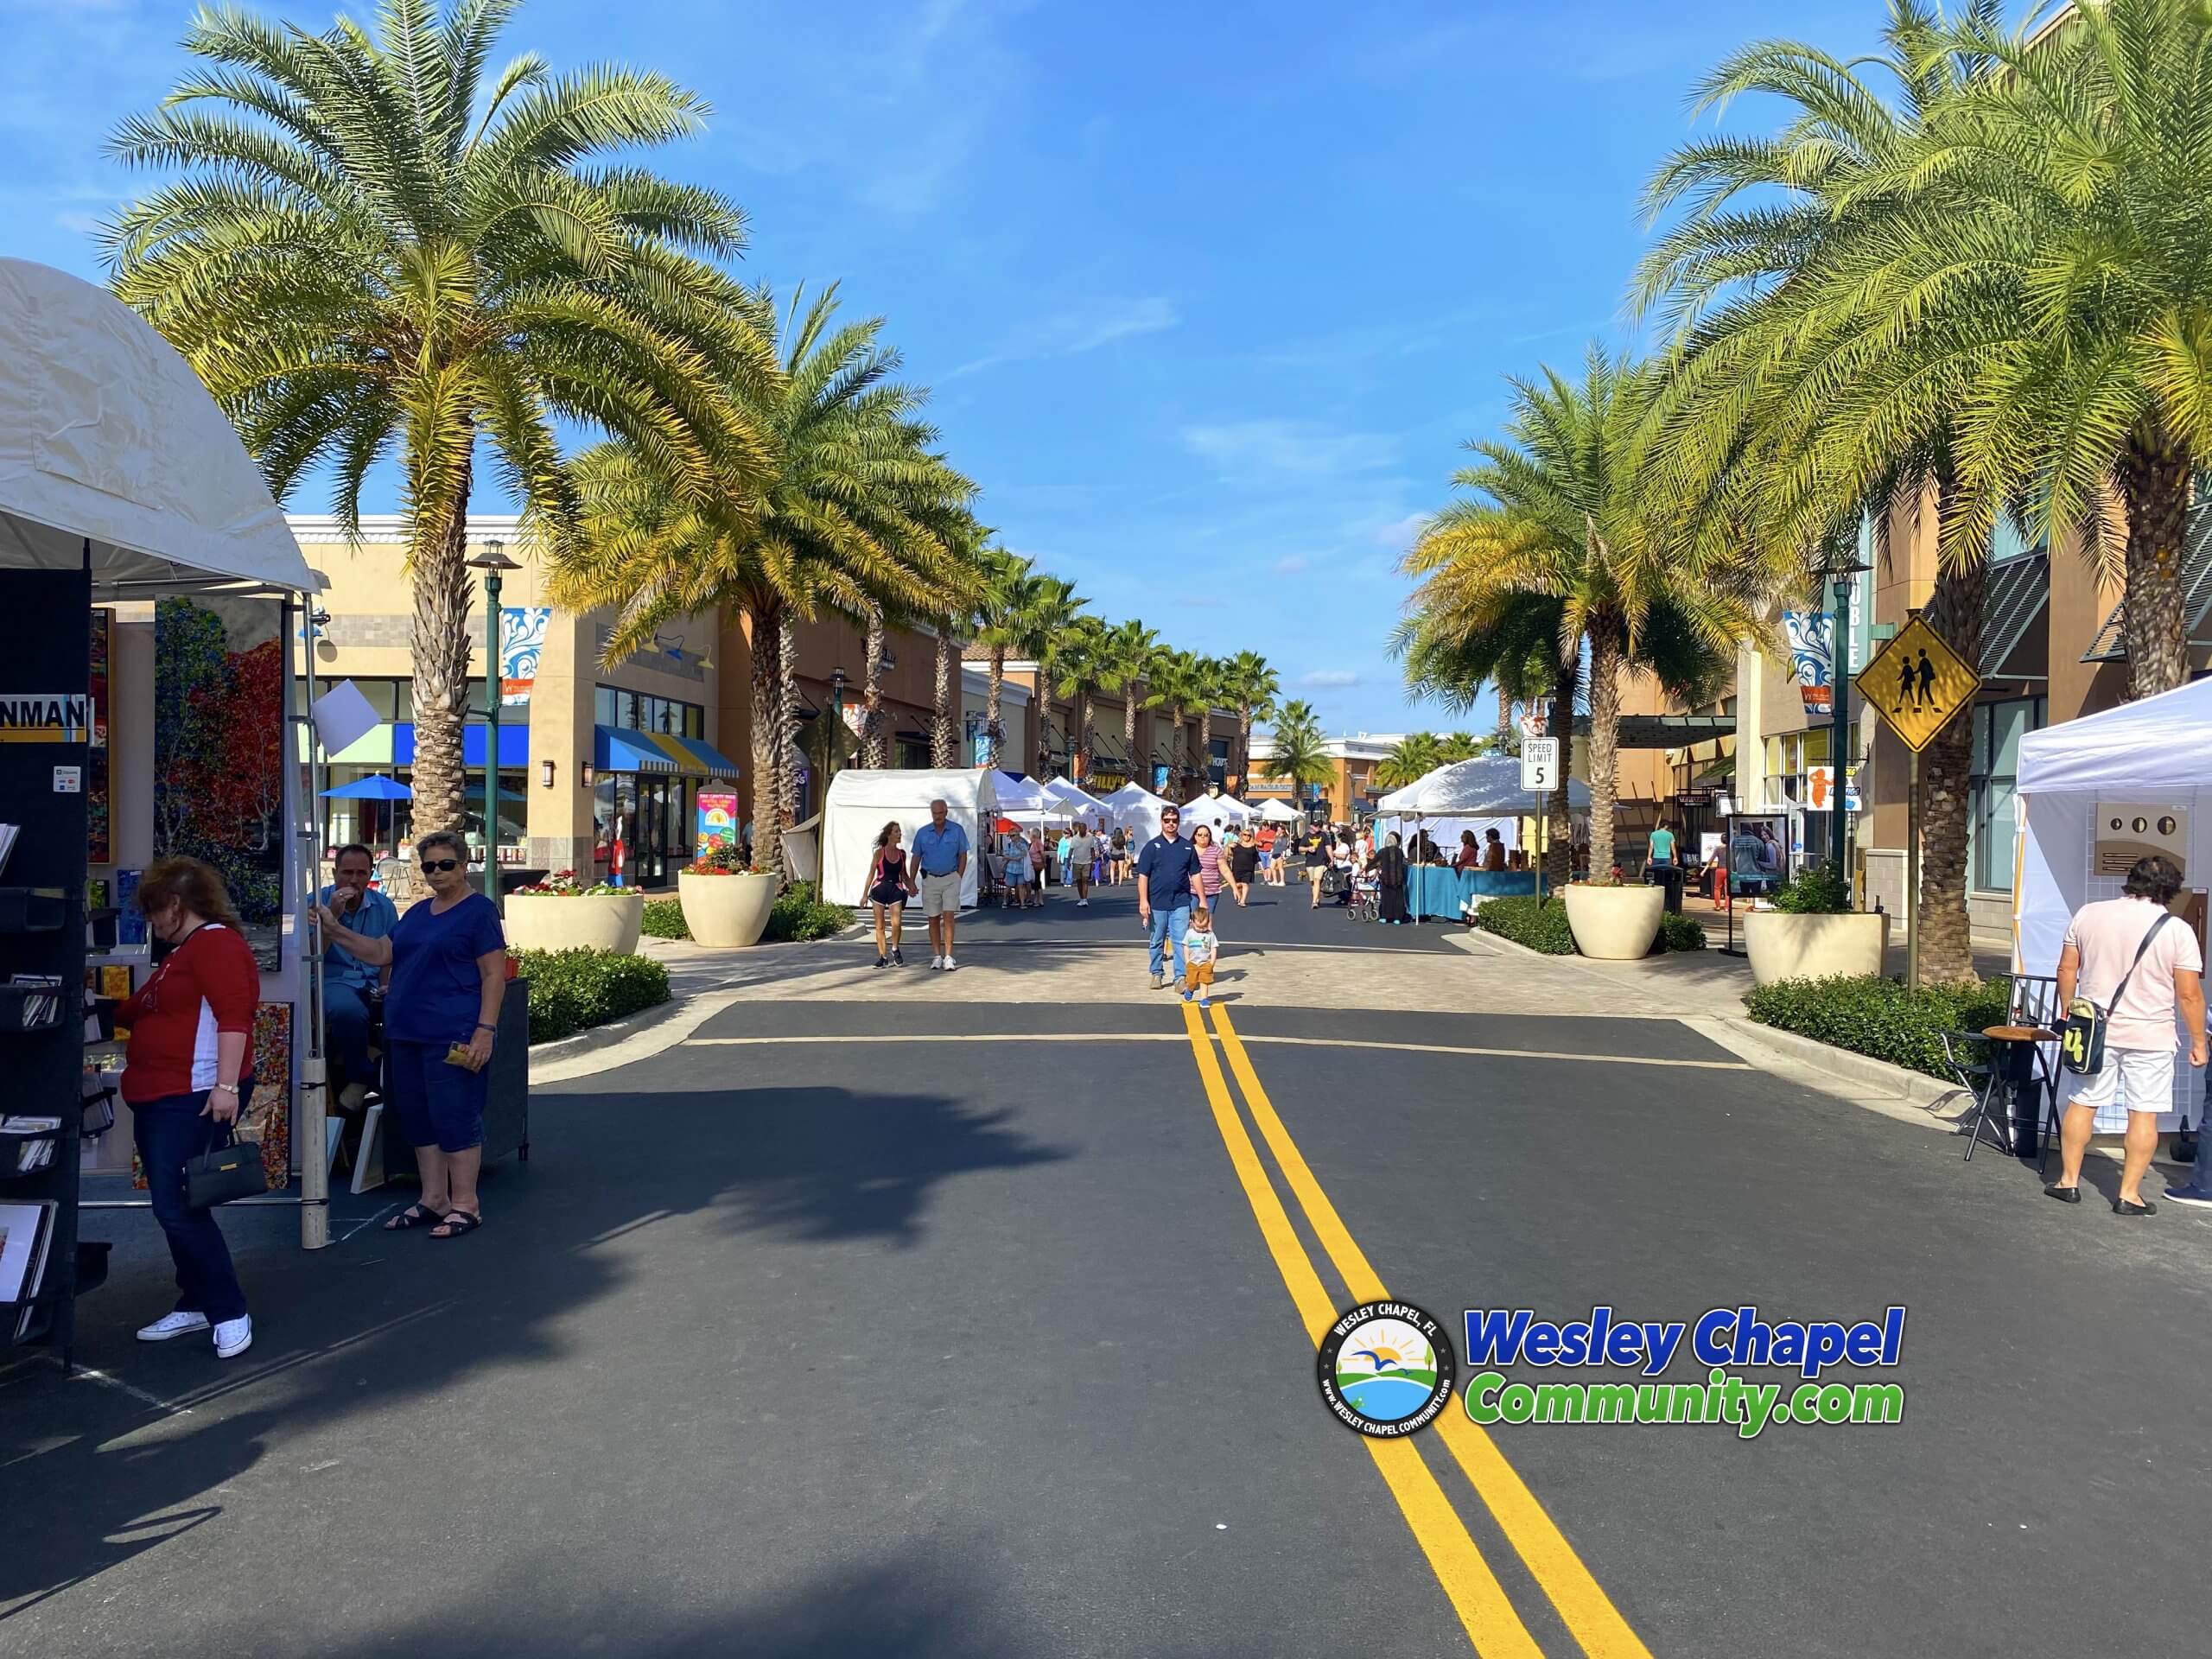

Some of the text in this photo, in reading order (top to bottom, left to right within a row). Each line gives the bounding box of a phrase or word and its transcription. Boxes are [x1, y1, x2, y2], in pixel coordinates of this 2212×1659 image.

[0, 701, 85, 728] NMAN
[1528, 743, 1552, 753] SPEED
[1528, 753, 1552, 762] LIMIT
[1535, 767, 1544, 784] 5
